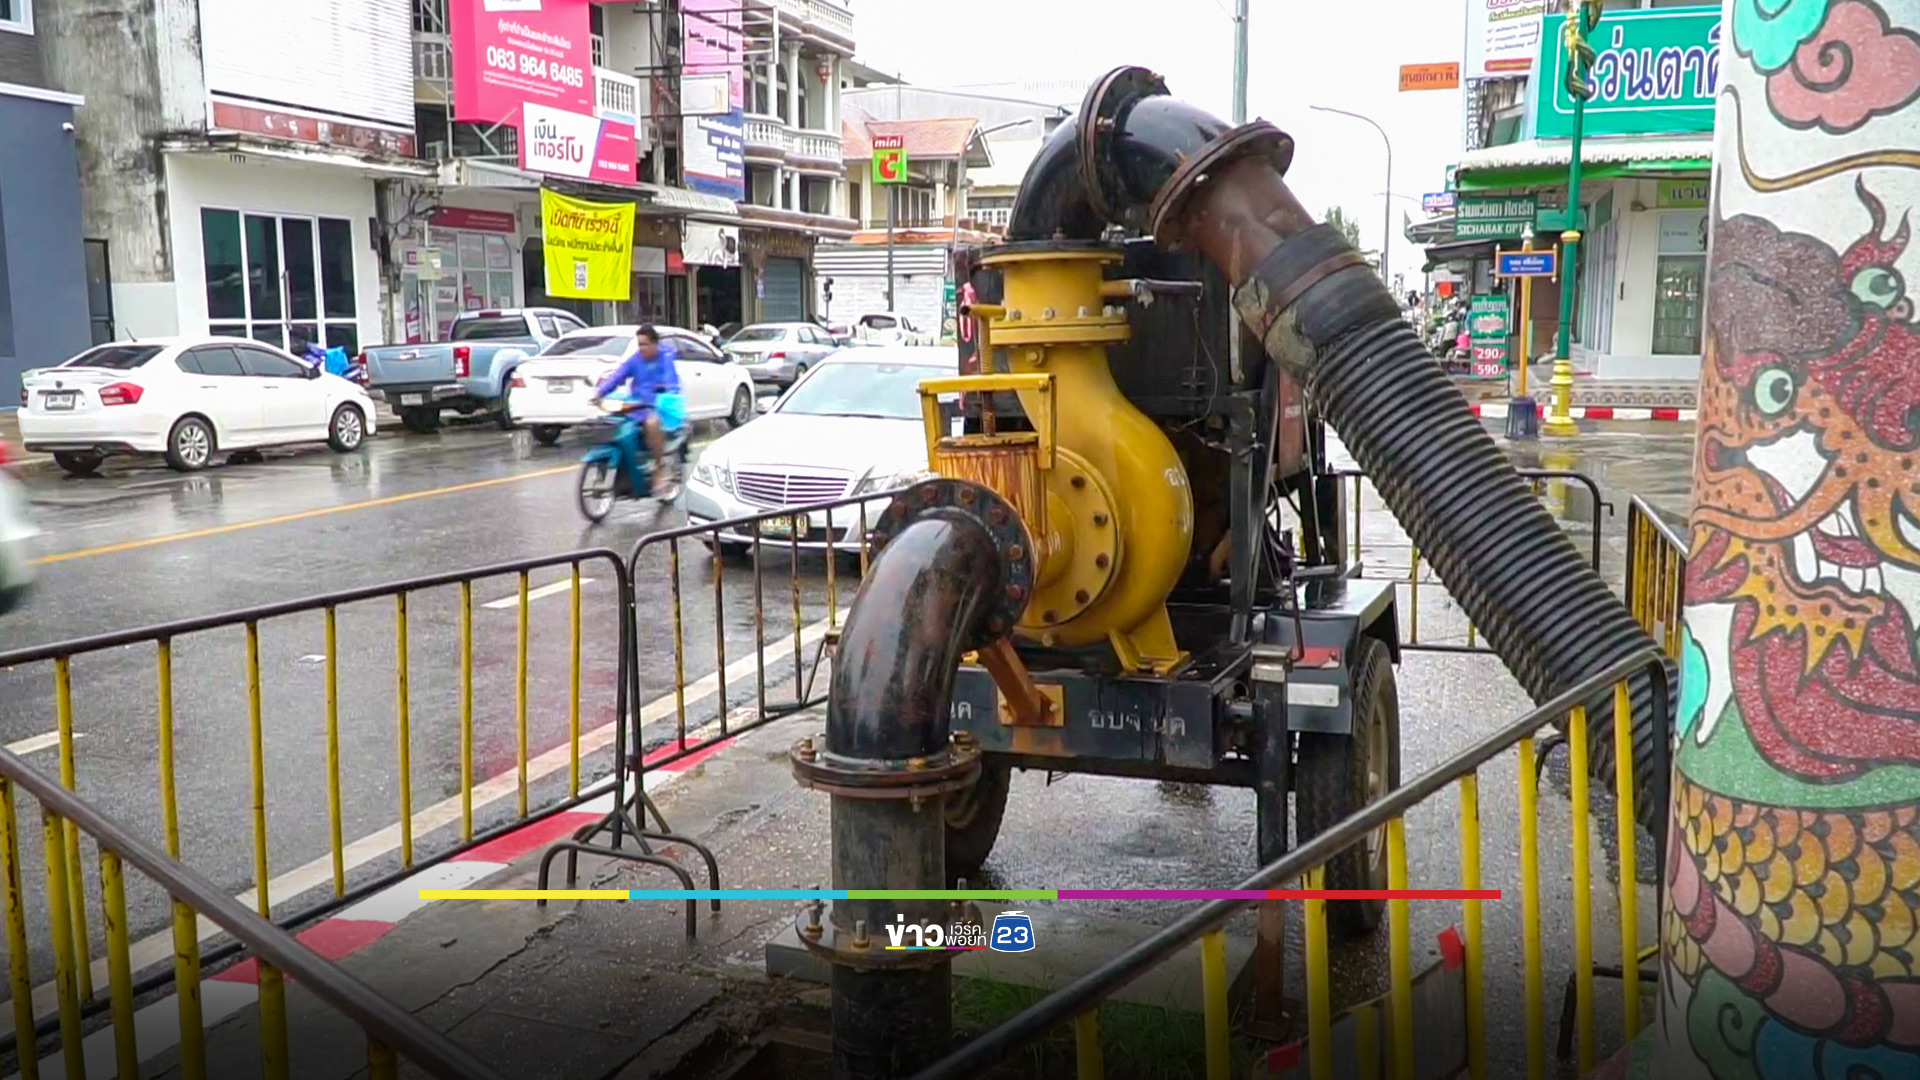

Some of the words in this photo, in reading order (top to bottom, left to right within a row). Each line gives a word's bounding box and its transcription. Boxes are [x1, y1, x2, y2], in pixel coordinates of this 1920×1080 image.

[486, 45, 516, 71] 063
[519, 54, 547, 79] 964
[550, 62, 583, 88] 6485
[1567, 22, 1720, 102] ว่นตา
[534, 118, 557, 140] เงิน
[534, 136, 584, 163] เทอร์โบ
[875, 137, 901, 148] mini
[1457, 223, 1504, 235] SICHARAK
[1505, 221, 1534, 234] OPT
